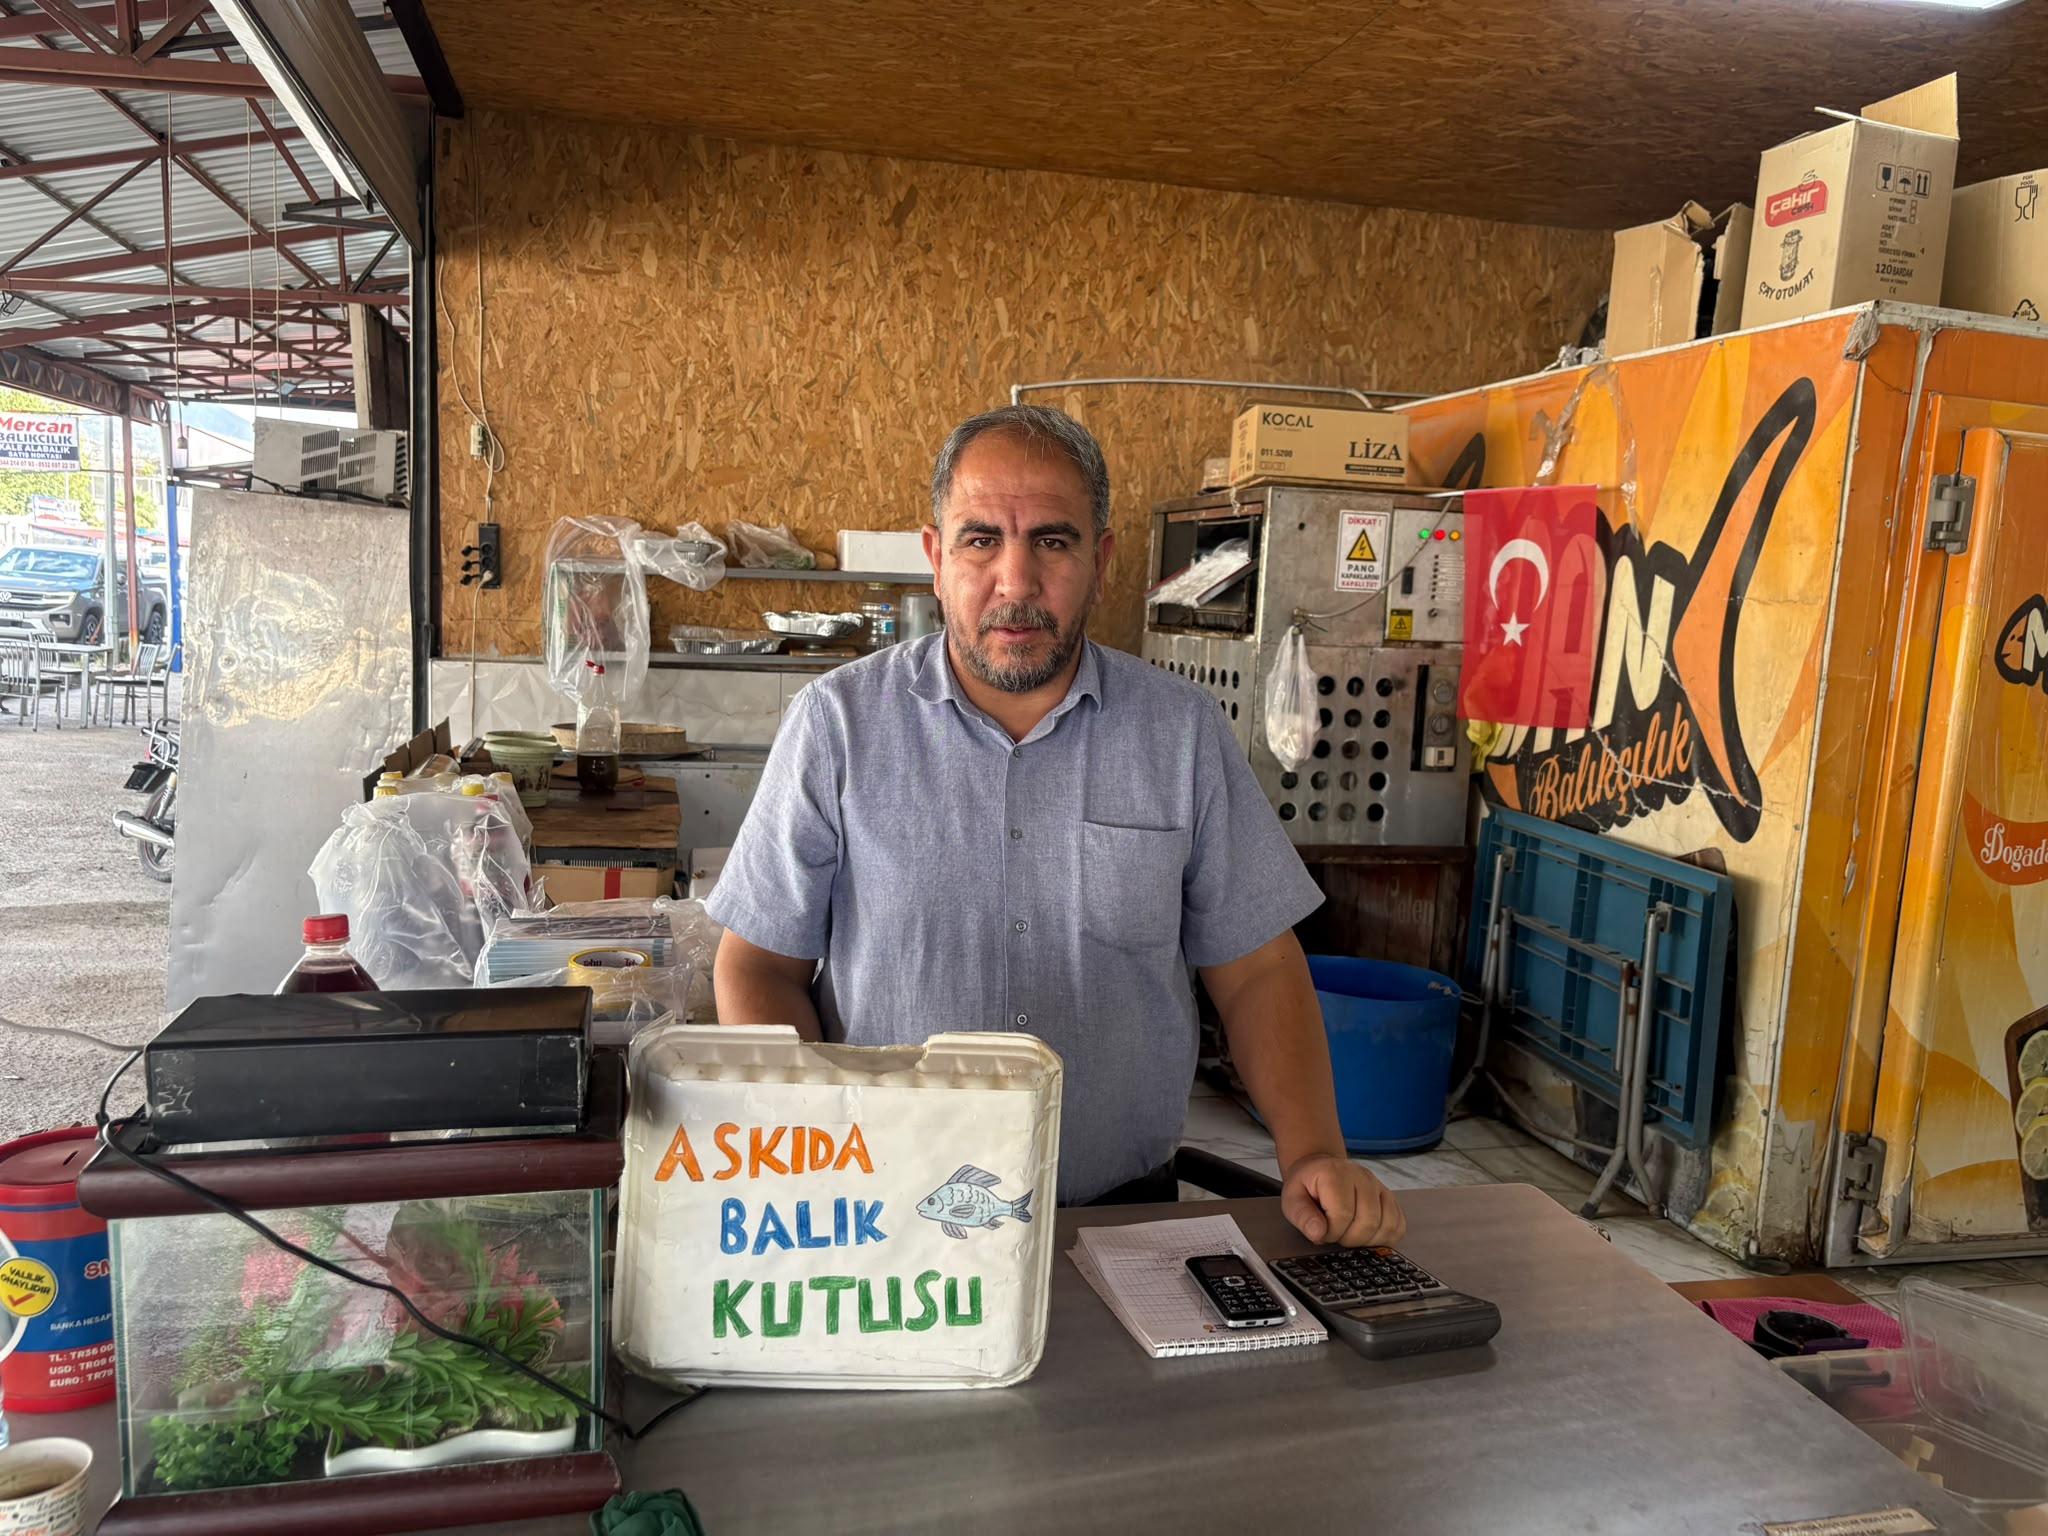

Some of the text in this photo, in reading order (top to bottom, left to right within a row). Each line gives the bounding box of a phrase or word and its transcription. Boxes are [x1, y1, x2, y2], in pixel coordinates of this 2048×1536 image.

[1875, 262, 1914, 278] 120 BARDAK
[1758, 281, 1775, 300] ÇAY
[0, 416, 73, 434] Mercan
[1262, 411, 1315, 429] KOCAL
[24, 444, 71, 454] ALABALIK
[1348, 438, 1403, 461] LİZA
[1347, 564, 1376, 573] PANO
[653, 1121, 876, 1183] ASKIDA
[720, 1196, 889, 1257] BALIK
[711, 1268, 984, 1339] KUTUSU
[50, 1317, 83, 1332] BANKA
[49, 1353, 67, 1363] TL:
[49, 1364, 76, 1376] USD:
[49, 1374, 84, 1388] EURO:
